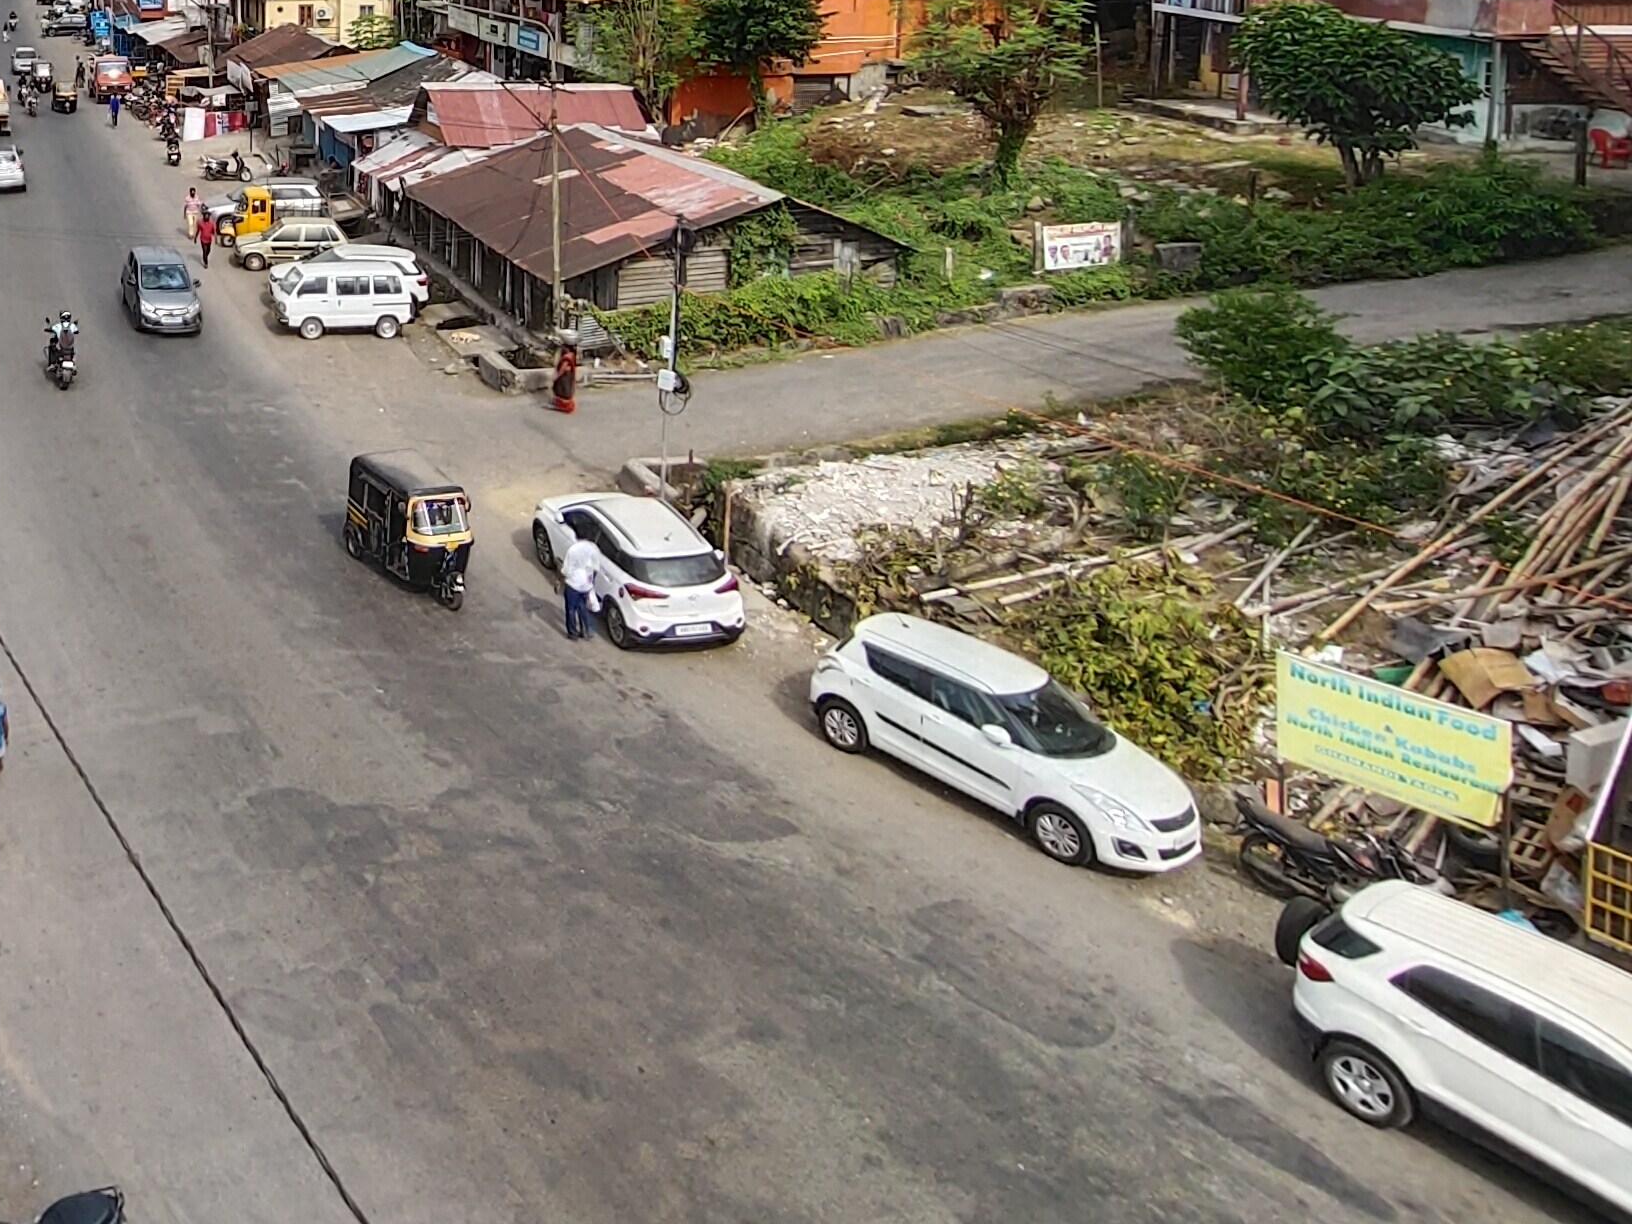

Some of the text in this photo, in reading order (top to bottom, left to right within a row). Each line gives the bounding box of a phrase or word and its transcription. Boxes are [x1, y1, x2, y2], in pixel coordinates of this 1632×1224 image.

[1289, 661, 1498, 742] North Indian Food
[1307, 706, 1387, 743] Chicken
[1286, 713, 1334, 738] North
[1339, 732, 1394, 759] Indian
